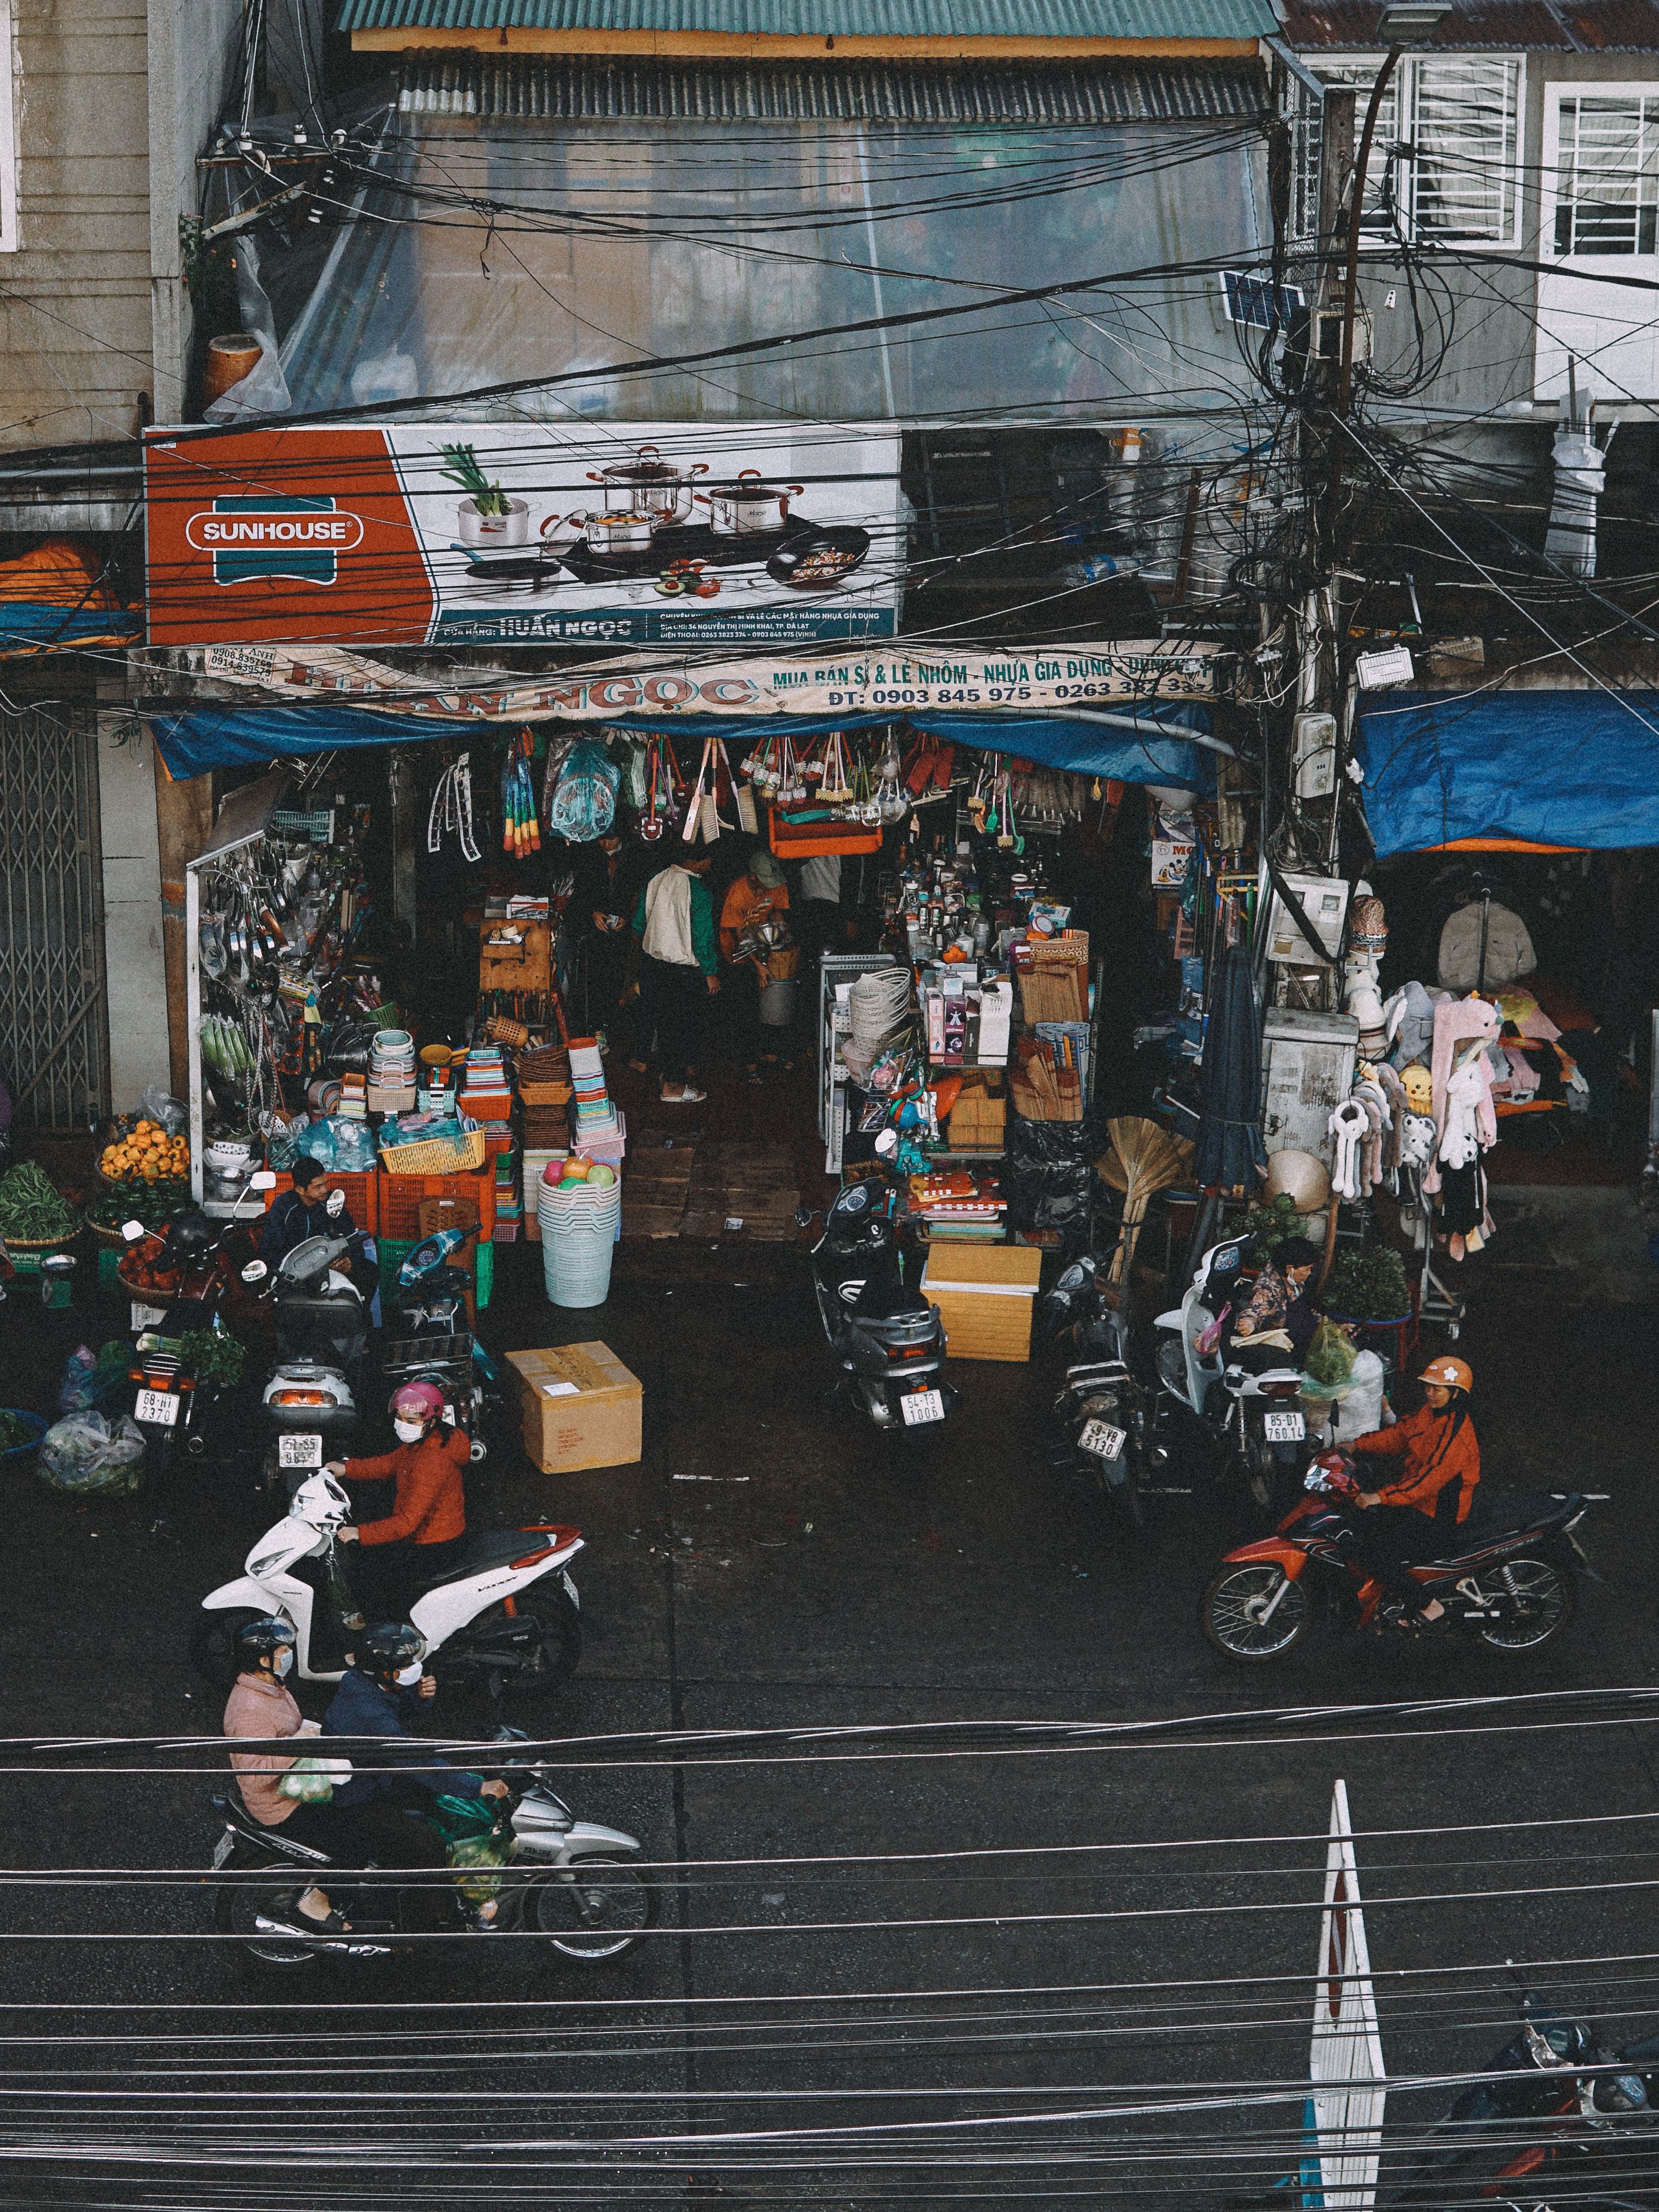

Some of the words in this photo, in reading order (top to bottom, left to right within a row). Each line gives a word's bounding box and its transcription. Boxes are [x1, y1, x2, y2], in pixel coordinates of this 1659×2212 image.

[204, 522, 346, 540] SUNHOUSE
[875, 664, 886, 684] &
[918, 660, 968, 684] NHÔM
[984, 659, 1030, 684] NHỰA
[1034, 661, 1062, 681] GIA
[1067, 658, 1112, 682] DỤNG
[829, 691, 865, 706] ĐT:
[872, 689, 928, 704] 0903
[938, 688, 980, 703] 845
[989, 687, 1031, 701] 975
[1055, 683, 1112, 698] 0263
[144, 1393, 172, 1408] 68-H1
[908, 1393, 935, 1409] 54-T3
[142, 1406, 170, 1422] 2370
[910, 1406, 939, 1422] 1006
[1270, 1414, 1297, 1426] 85-D1
[1267, 1427, 1303, 1440] 760.14
[1085, 1434, 1113, 1455] 5130
